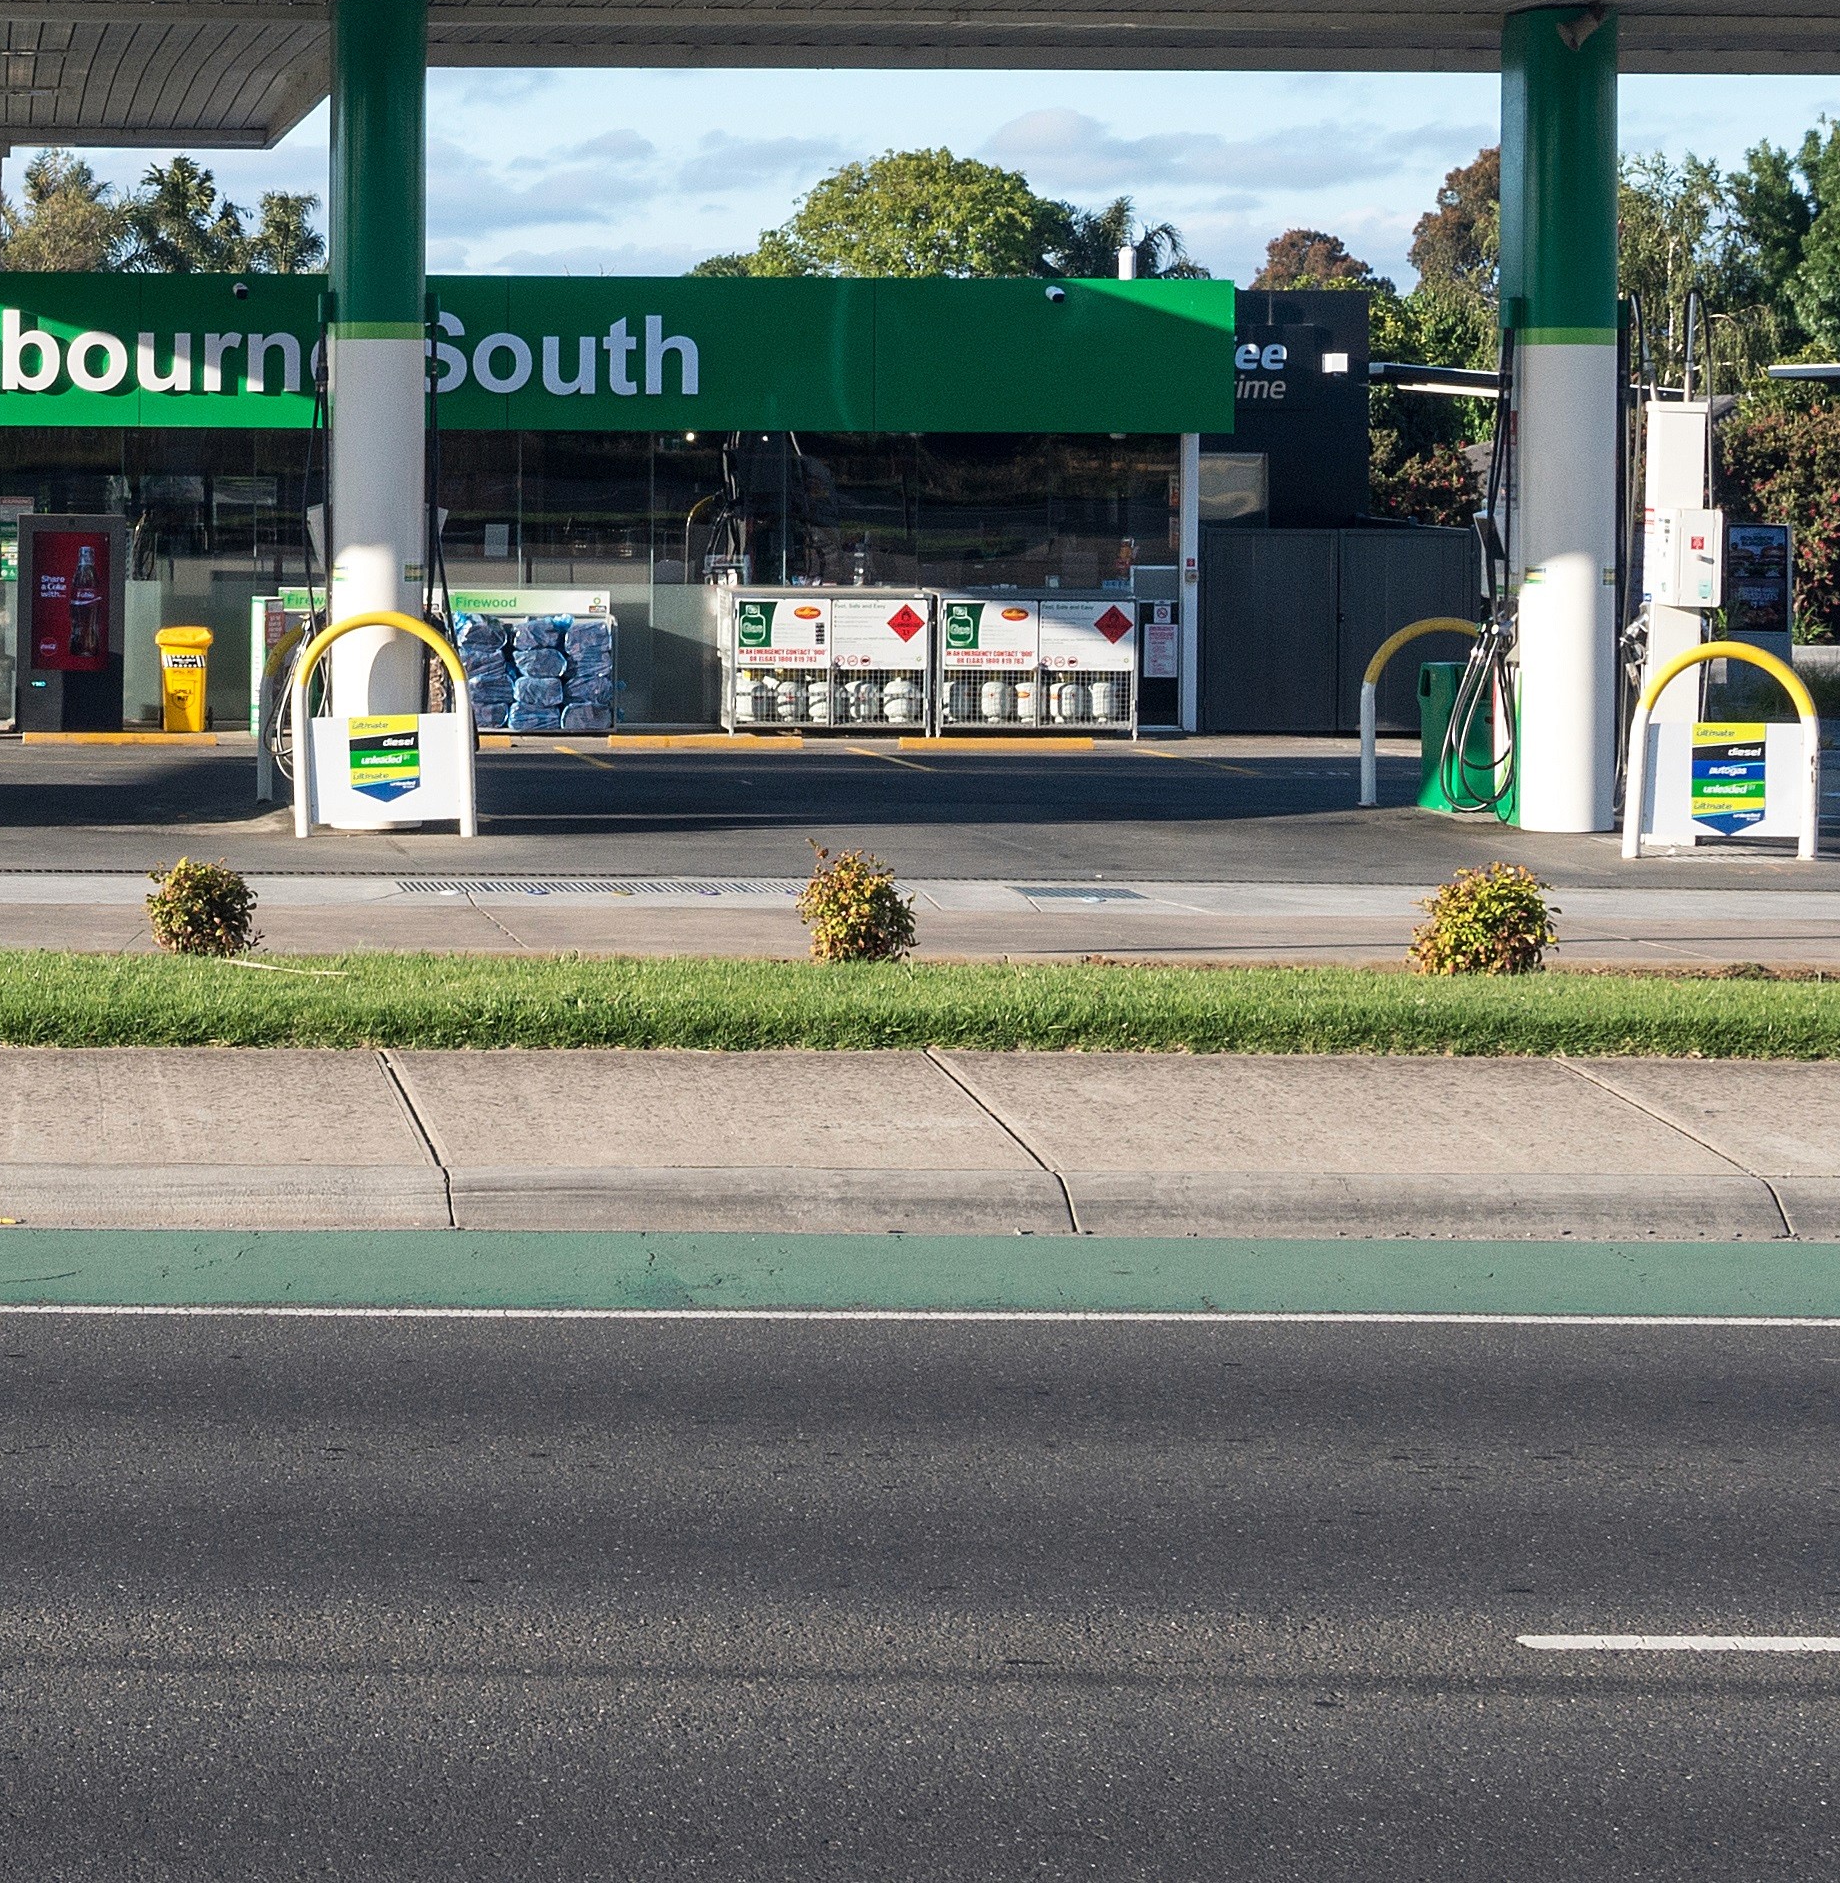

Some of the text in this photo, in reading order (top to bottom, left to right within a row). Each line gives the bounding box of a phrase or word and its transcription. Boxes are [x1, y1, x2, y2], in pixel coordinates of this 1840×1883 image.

[423, 310, 699, 396] South
[1234, 375, 1287, 400] ime
[41, 575, 66, 583] Share
[455, 596, 518, 608] Firewood
[382, 737, 415, 747] diesel
[1728, 747, 1762, 757] diesel
[361, 755, 403, 765] unleaded
[1709, 766, 1747, 777] autogas
[1703, 784, 1748, 794] unleaded
